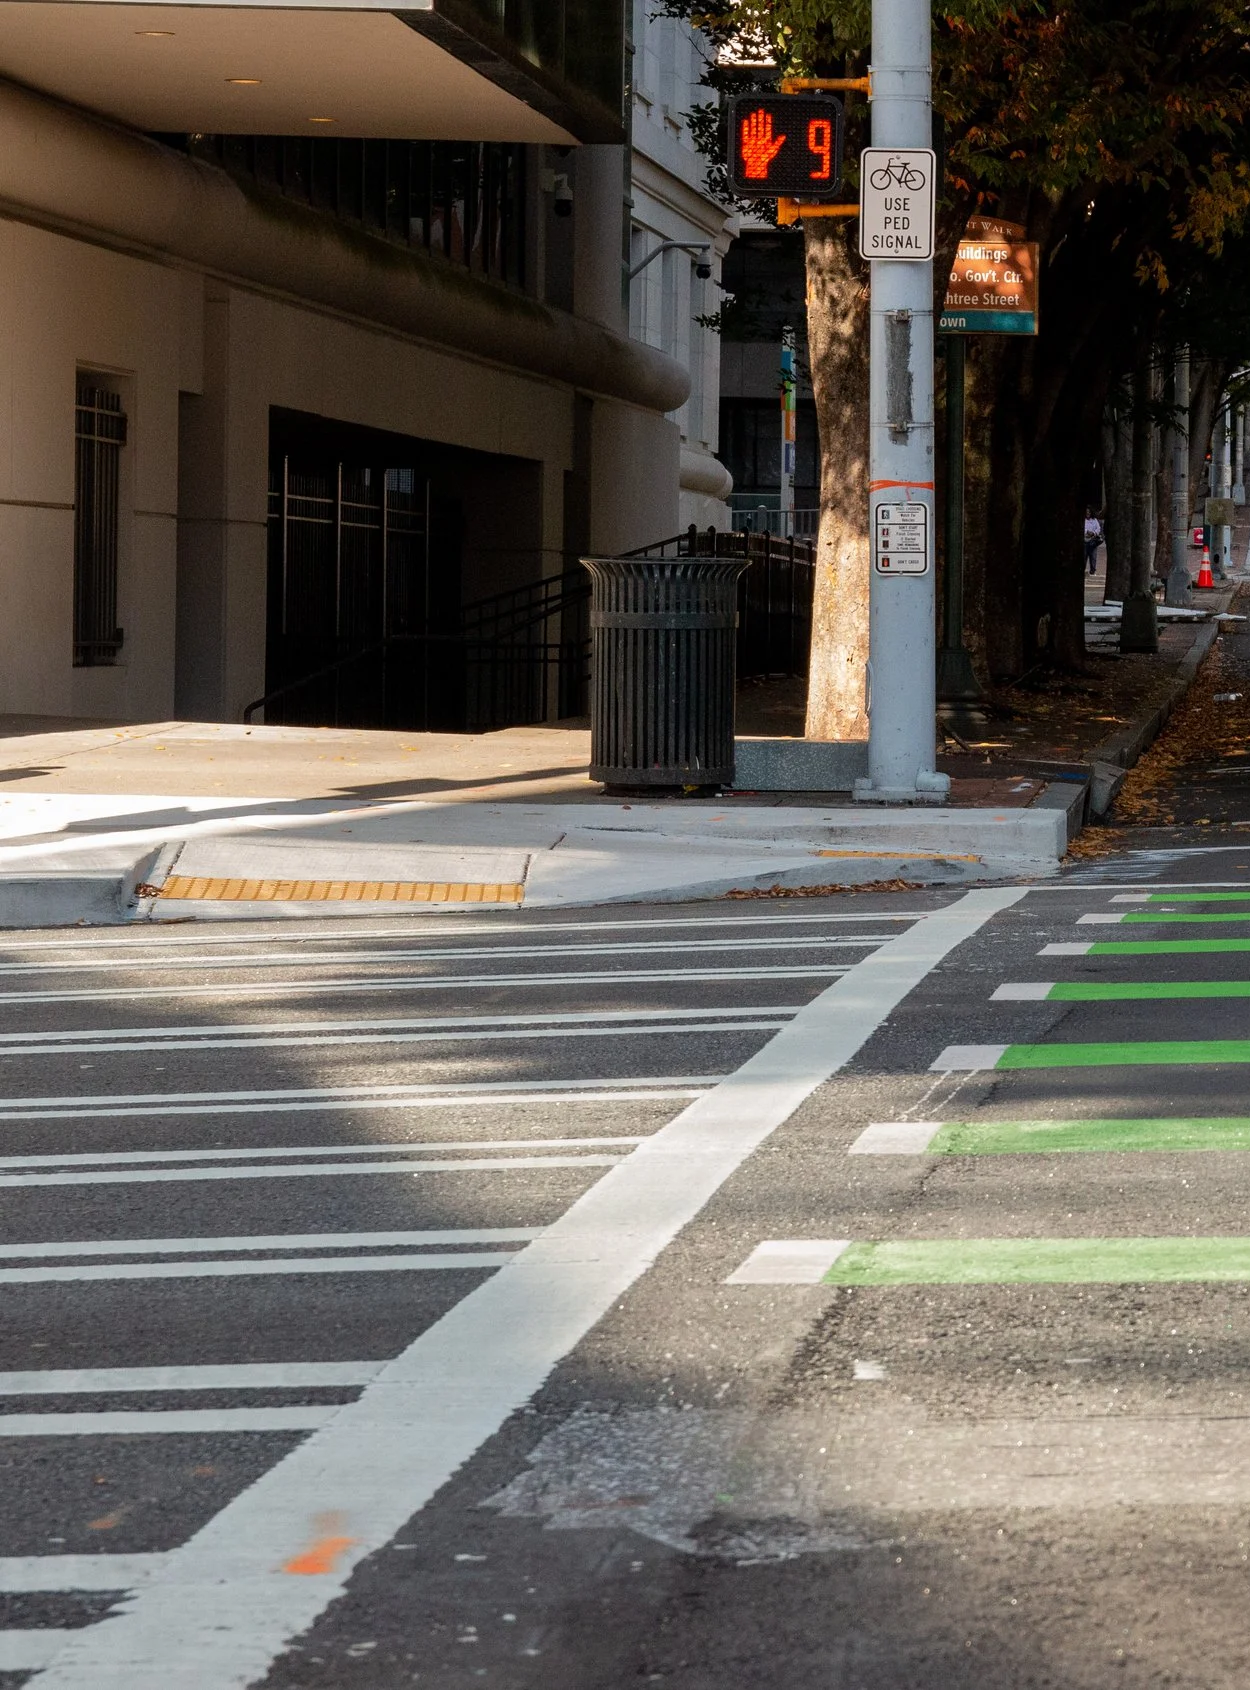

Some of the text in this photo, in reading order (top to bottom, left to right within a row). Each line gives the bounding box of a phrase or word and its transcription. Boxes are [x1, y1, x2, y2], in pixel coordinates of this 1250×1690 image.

[808, 119, 831, 179] 9
[884, 197, 910, 211] USE
[884, 217, 910, 230] PED
[980, 221, 1012, 235] WALK
[871, 235, 922, 249] SIGNAL
[956, 247, 1008, 263] uildings
[950, 272, 961, 282] o.
[1003, 271, 1023, 283] Ctr.
[944, 292, 1020, 306] htree Street
[940, 317, 966, 328] own
